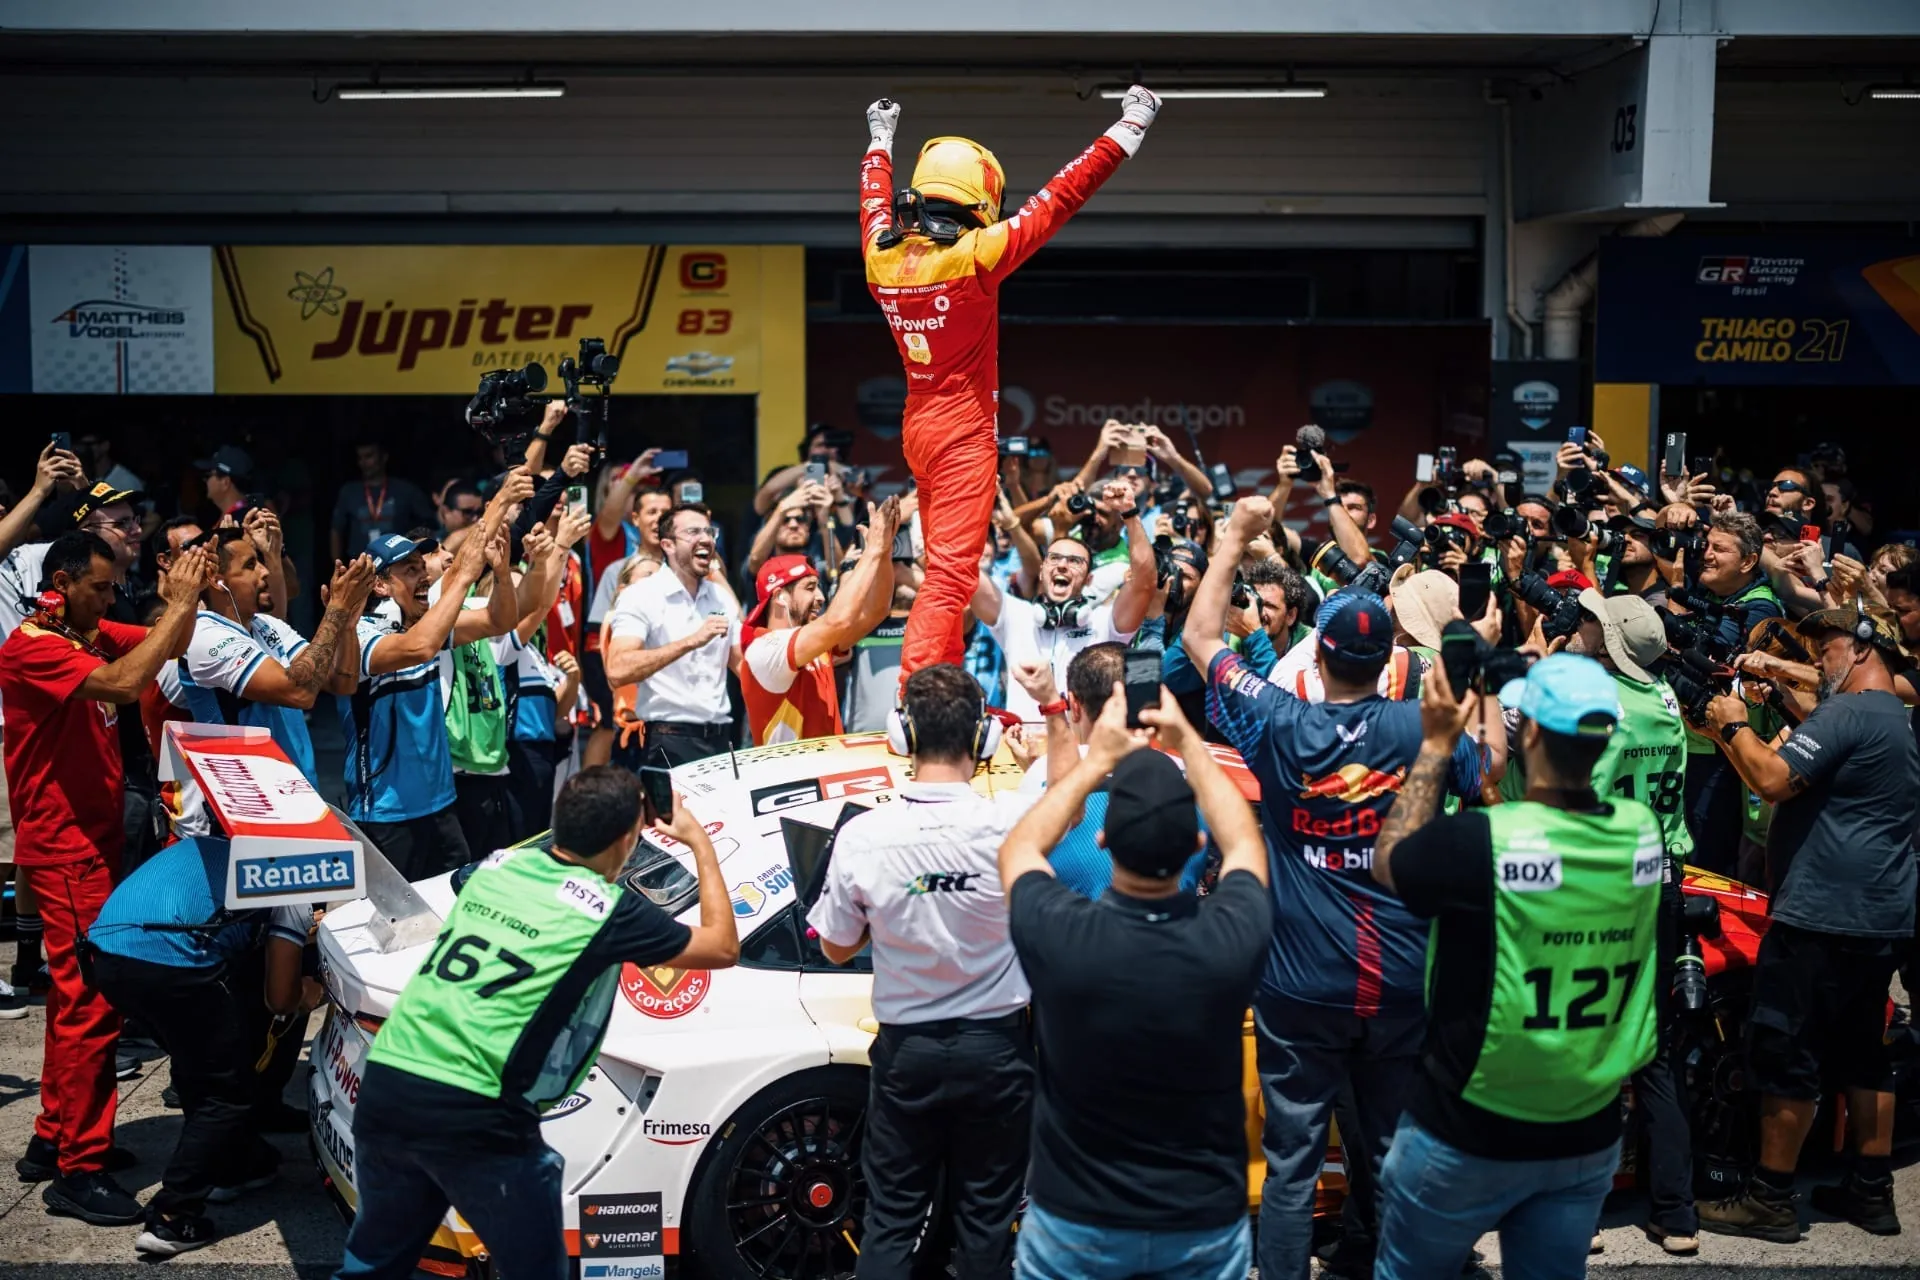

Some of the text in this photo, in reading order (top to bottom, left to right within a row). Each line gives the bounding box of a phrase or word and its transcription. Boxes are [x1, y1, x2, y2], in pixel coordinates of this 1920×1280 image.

[1749, 266, 1799, 275] GAZOO
[1752, 257, 1805, 266] TOYOTA
[1700, 266, 1743, 281] GR
[1748, 275, 1796, 285] acing
[1731, 286, 1767, 296] Brasil
[881, 299, 899, 312] hell
[677, 308, 733, 335] 83
[311, 298, 594, 372] Júpiter
[1701, 318, 1850, 361] THIAGO 21
[1695, 341, 1791, 362] CAMILO
[73, 503, 90, 522] 1ST
[1623, 746, 1650, 759] FOTO
[1292, 807, 1388, 838] Red B
[1303, 844, 1375, 870] Mobil
[242, 858, 350, 889] Renata
[757, 863, 783, 882] GRUPO
[1503, 861, 1555, 883] BOX
[564, 880, 606, 914] PISTA
[462, 900, 490, 916] FOTO
[490, 911, 502, 920] E
[1542, 931, 1585, 946] FOTO
[1587, 931, 1596, 945] E
[419, 927, 537, 999] 167
[627, 977, 704, 1012] 3 corações
[1522, 960, 1642, 1031] 127
[643, 1119, 711, 1135] Frimesa
[605, 1263, 662, 1279] Mangels
